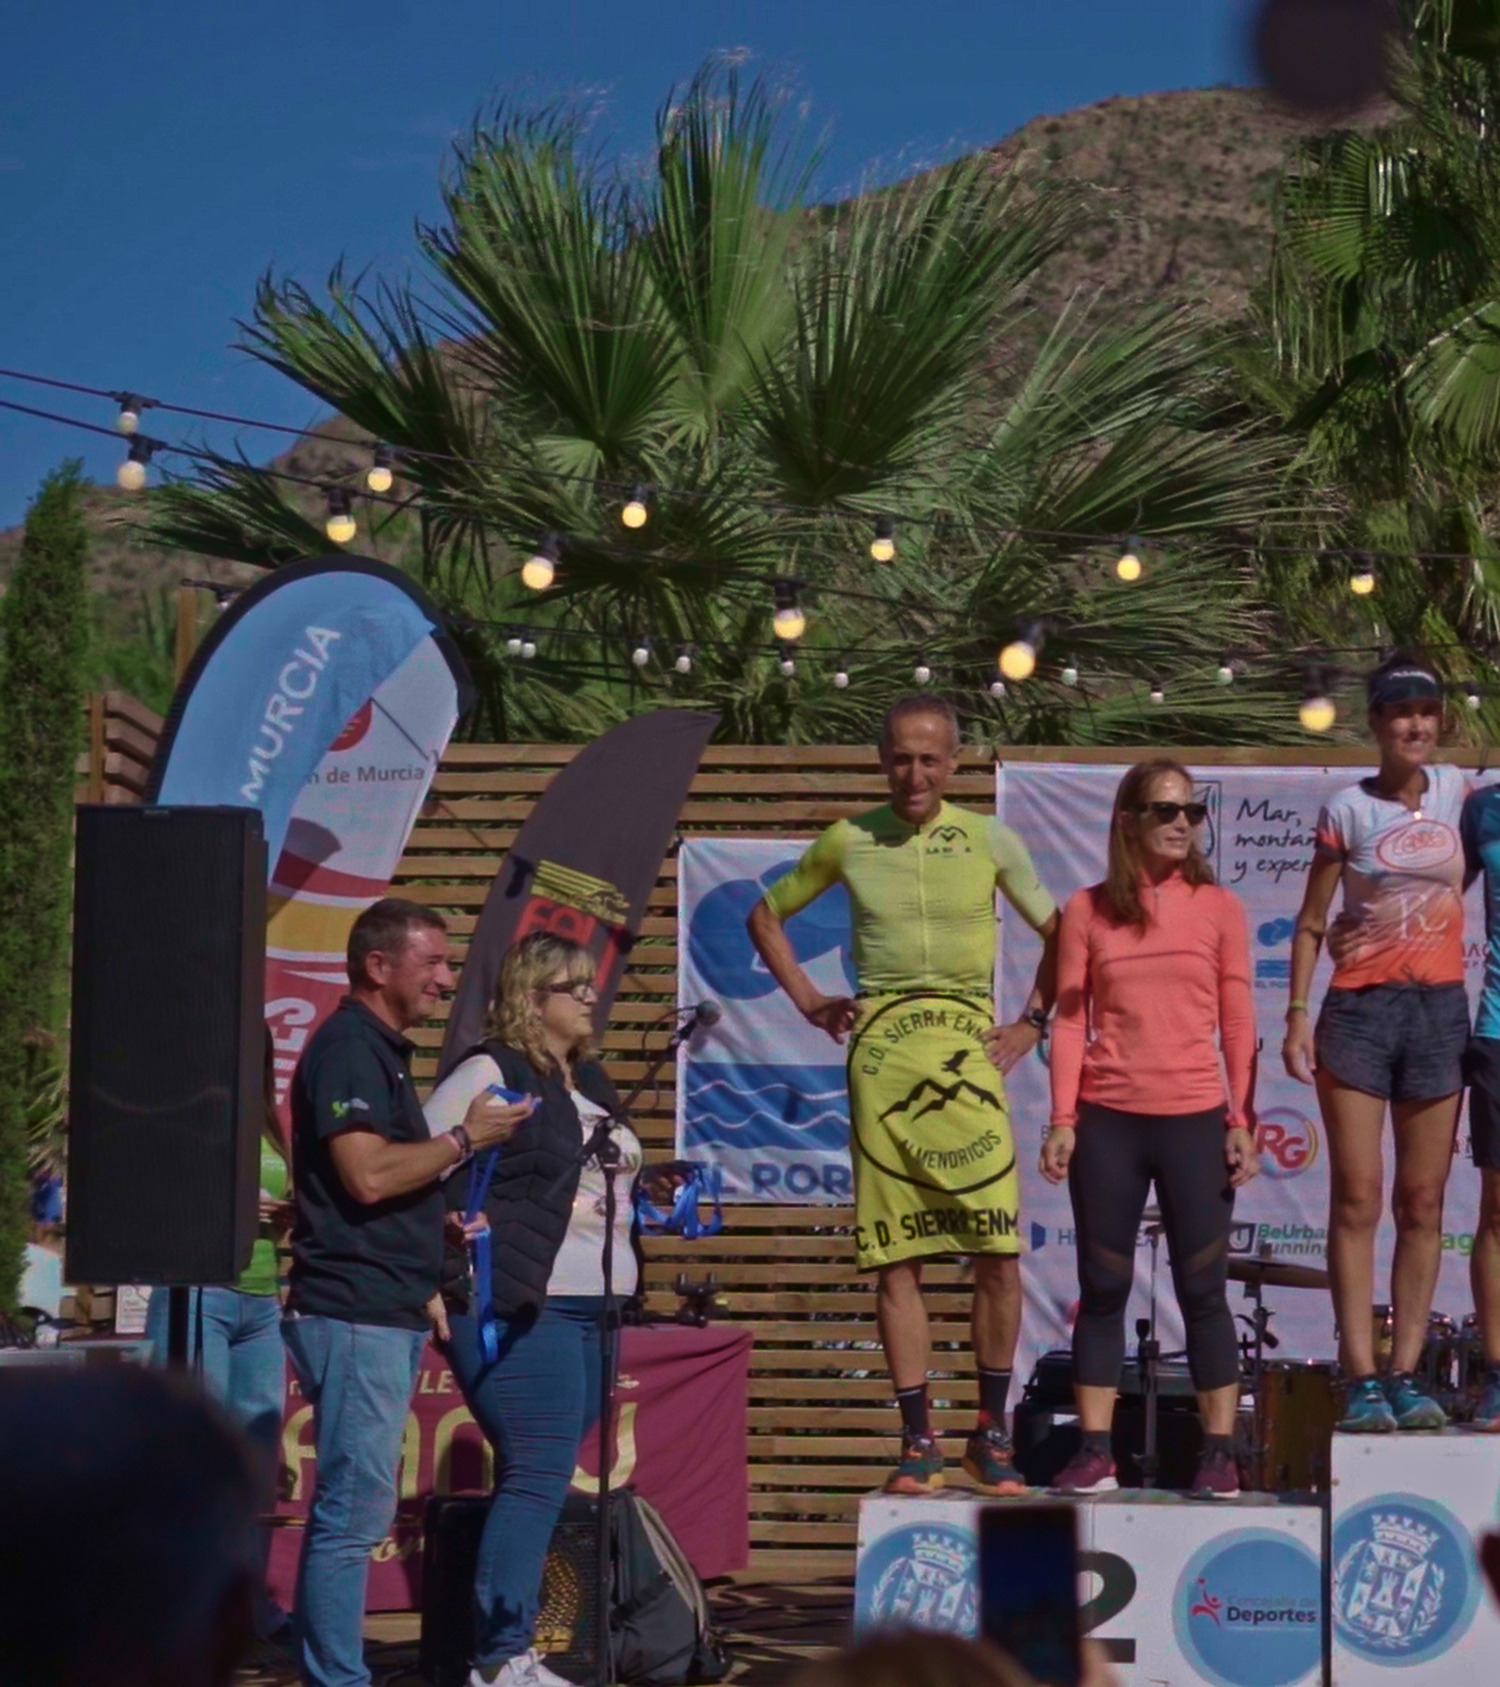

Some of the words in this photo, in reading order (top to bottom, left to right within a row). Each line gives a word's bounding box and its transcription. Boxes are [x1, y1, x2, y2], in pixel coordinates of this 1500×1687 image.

[240, 626, 341, 802] MURCIA
[326, 768, 350, 784] de
[357, 766, 425, 782] Murcia
[1236, 798, 1301, 827] Mar,
[1230, 861, 1248, 884] y
[884, 1009, 948, 1045] SIERRA
[1255, 1123, 1306, 1169] RG
[855, 1219, 896, 1251] C.D.
[1227, 1606, 1316, 1625] Deportes
